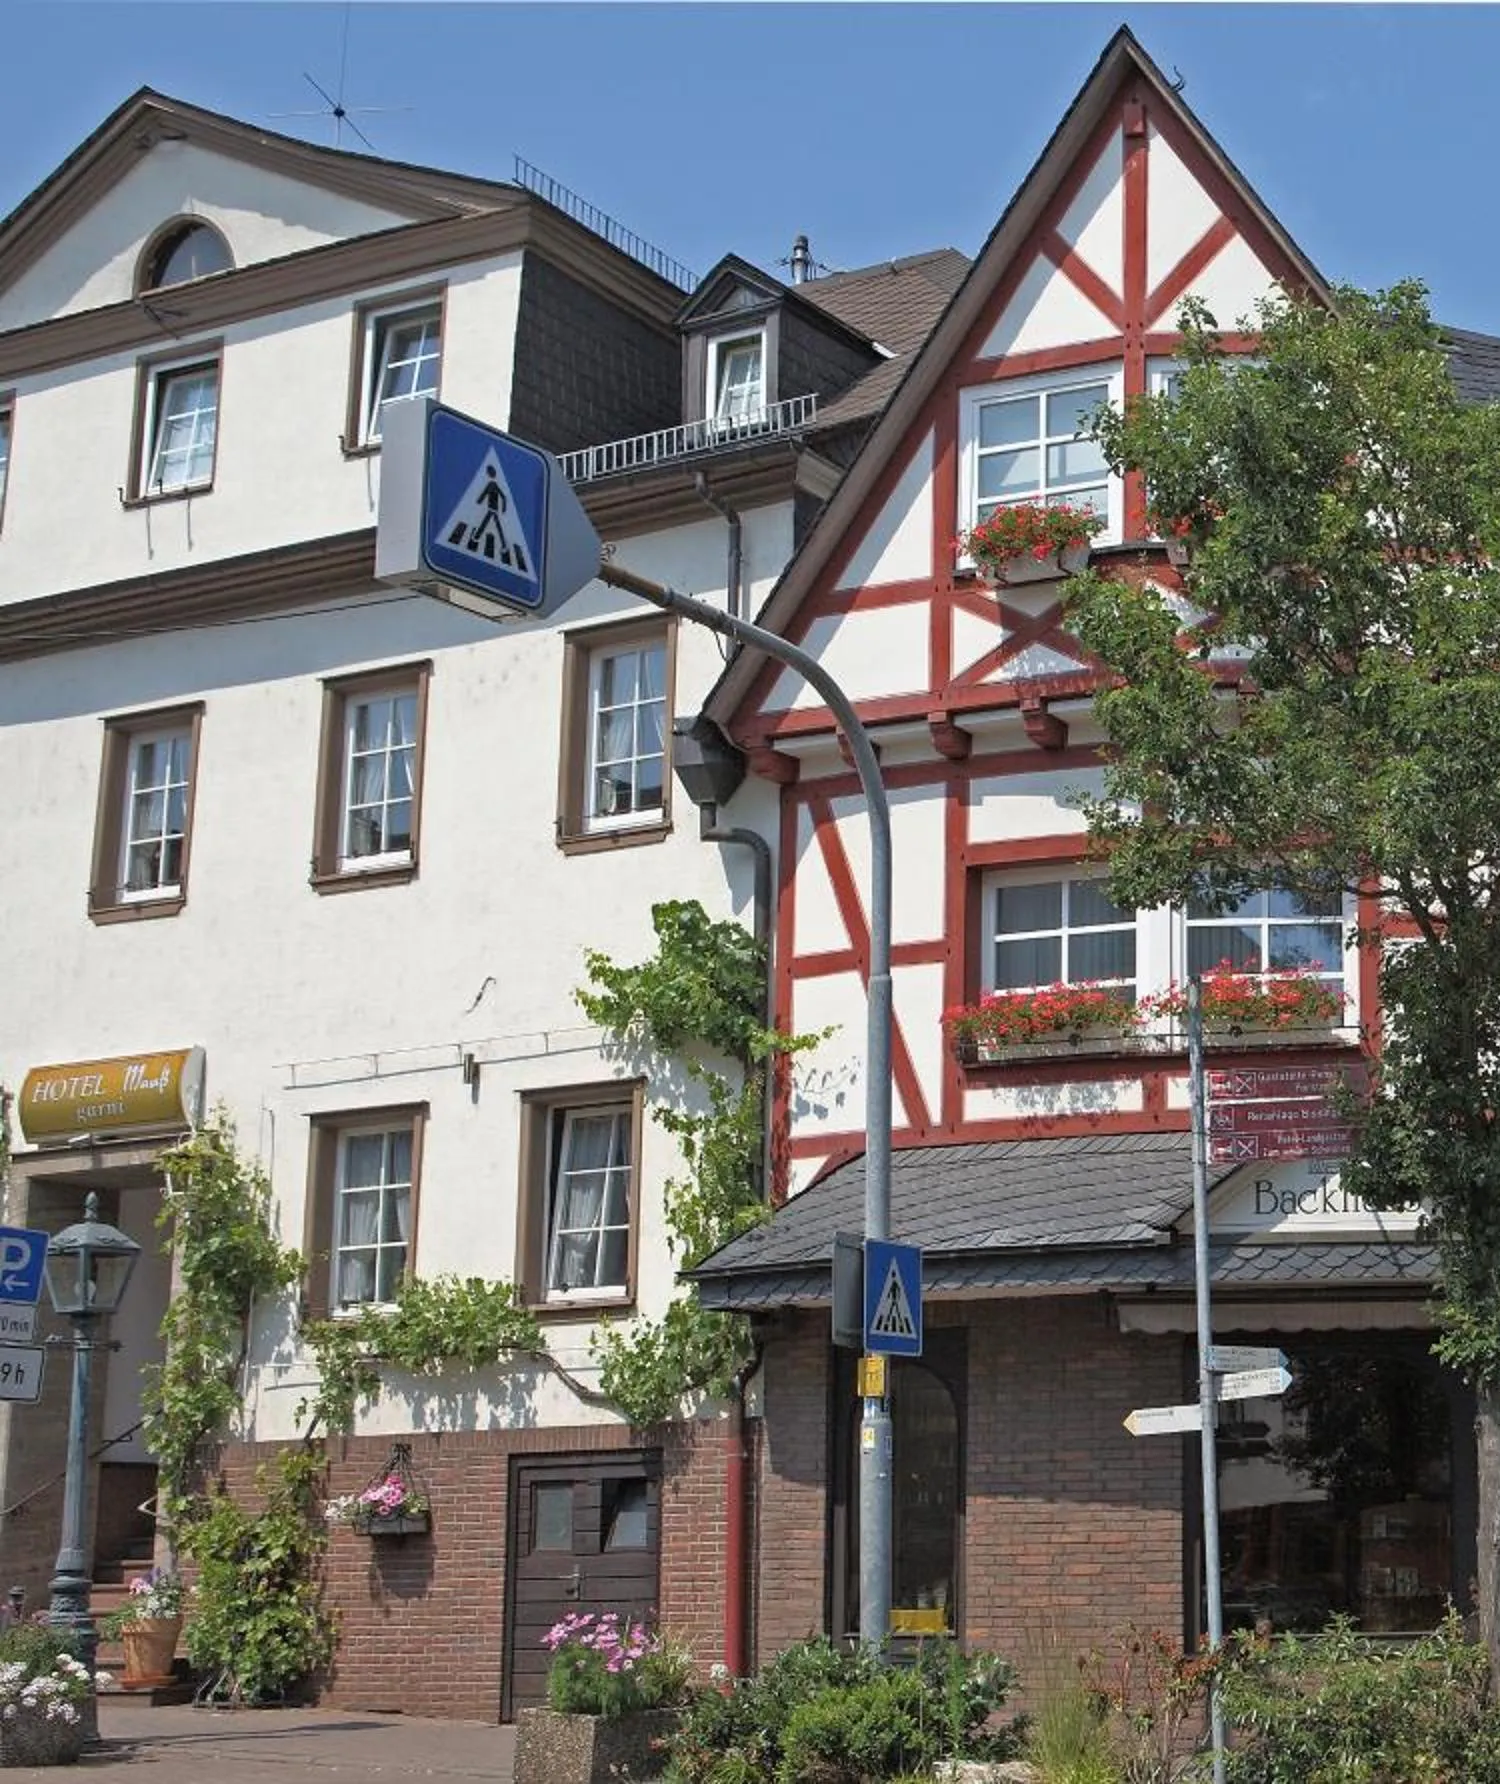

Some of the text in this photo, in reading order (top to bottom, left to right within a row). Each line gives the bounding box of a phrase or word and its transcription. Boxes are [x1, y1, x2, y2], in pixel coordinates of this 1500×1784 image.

[31, 1072, 105, 1103] HOTEL
[75, 1096, 127, 1124] garni
[0, 1237, 31, 1279] P
